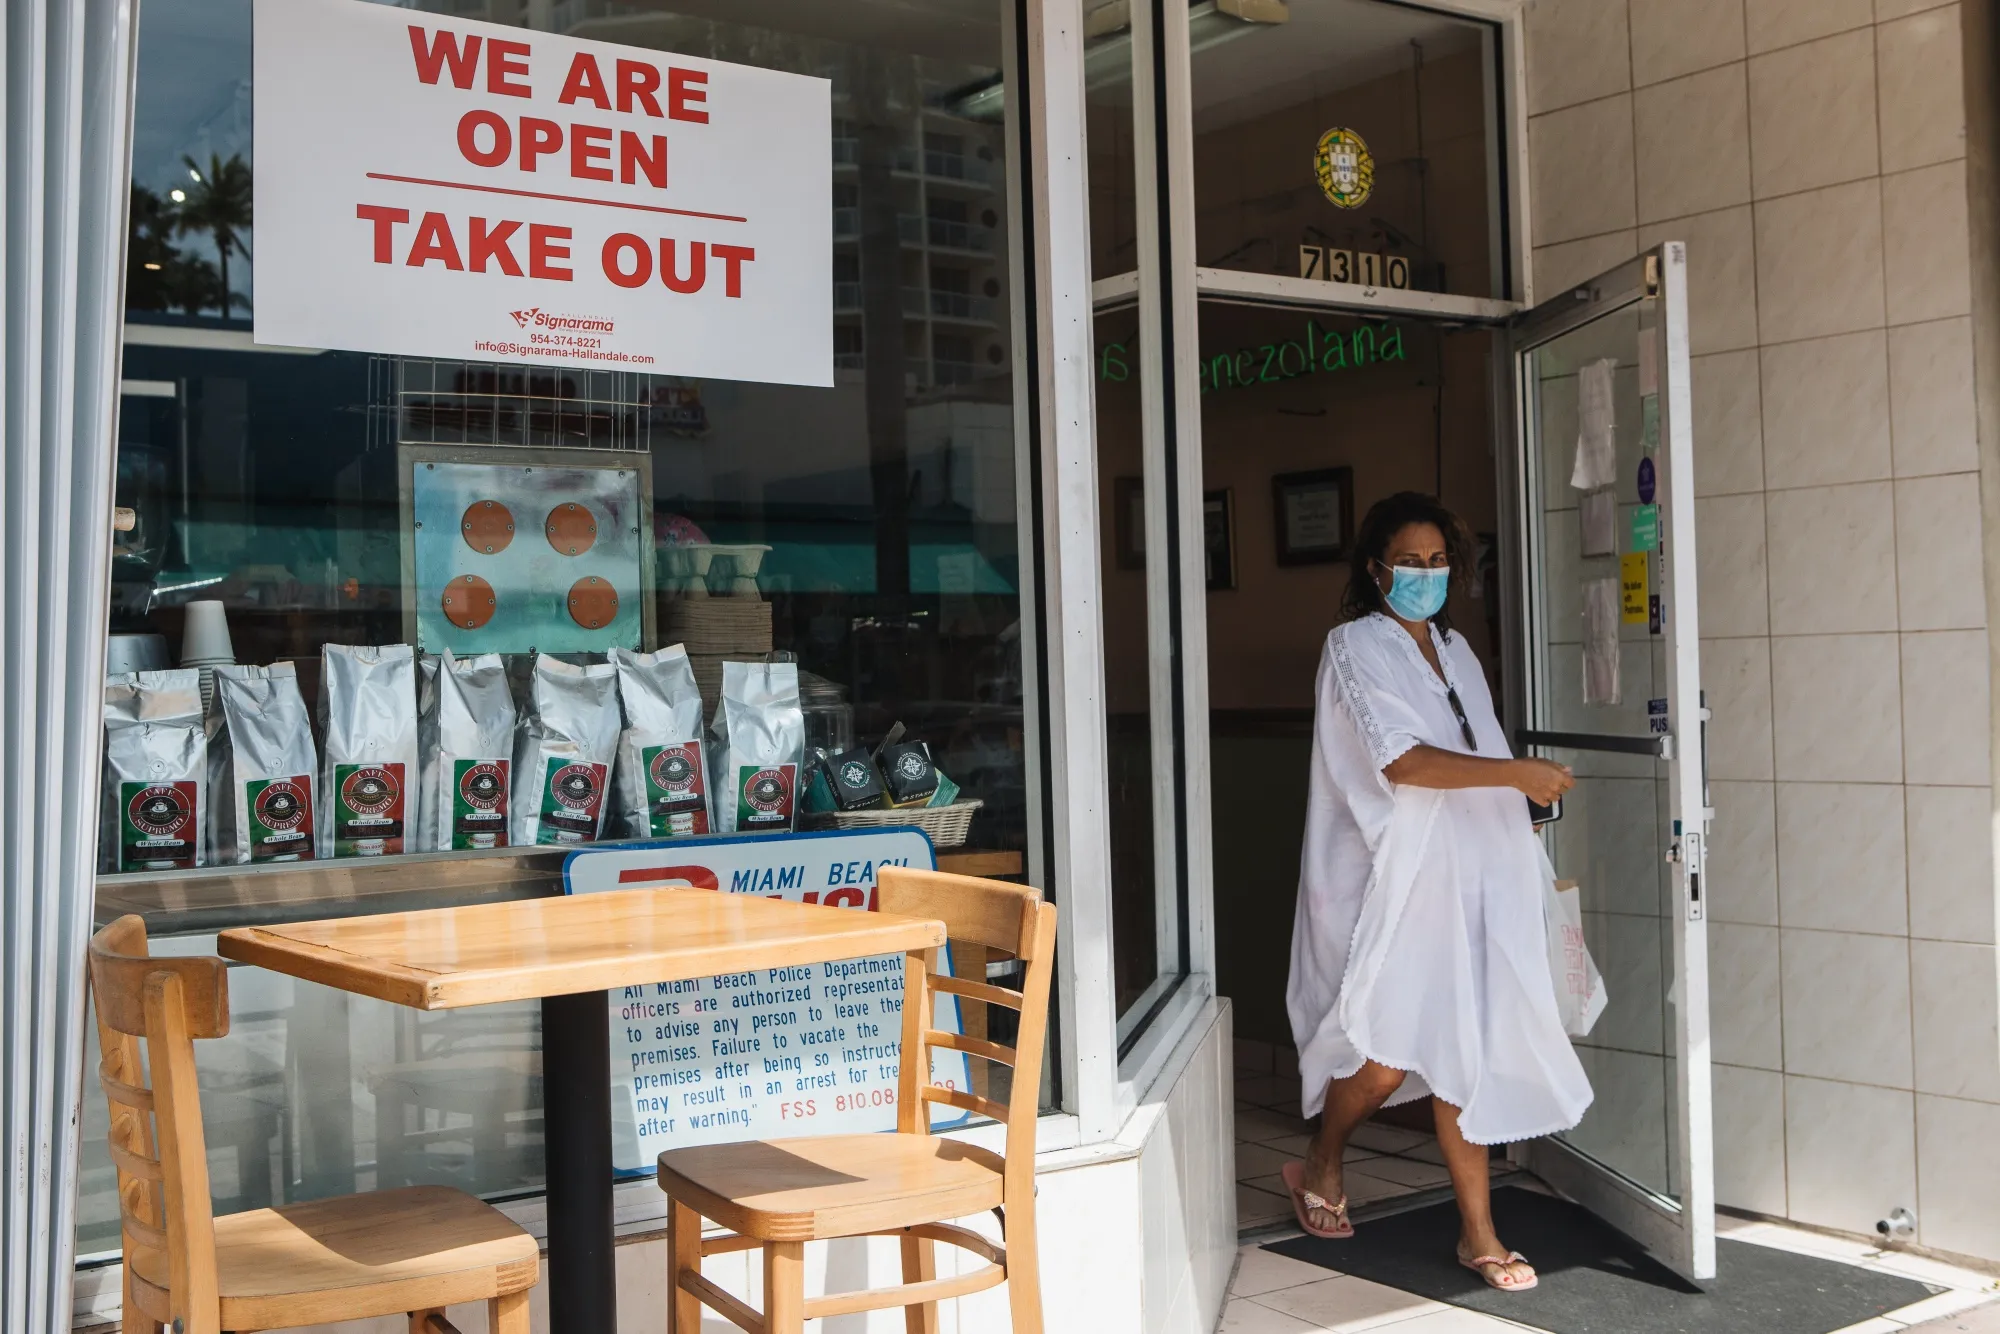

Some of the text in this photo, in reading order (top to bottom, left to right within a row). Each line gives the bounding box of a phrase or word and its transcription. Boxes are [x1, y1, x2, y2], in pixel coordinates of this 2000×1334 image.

[408, 25, 710, 125] WE ARE
[456, 110, 668, 189] OPEN
[356, 203, 755, 298] TAKE OUT
[1302, 248, 1407, 289] 7310
[534, 312, 614, 332] Signarama
[475, 340, 655, 364] info@Signarama-Hallandale.com
[530, 333, 601, 349] 954-374-8221
[1650, 717, 1668, 733] PUS
[656, 774, 695, 790] SUPREMO
[348, 798, 392, 814] SUPREMO
[464, 793, 502, 810] SUPREMO
[554, 790, 594, 809] SUPREMO
[748, 796, 785, 811] SUPREMO
[910, 790, 934, 800] STASH
[134, 817, 184, 834] SUPREMO
[261, 811, 303, 830] SUPREMO
[730, 866, 804, 893] MIAMI
[624, 956, 902, 999] All Miami Beach Police Department
[622, 975, 904, 1020] officers are authorized representat
[627, 1026, 642, 1043] to
[656, 1020, 700, 1040] advise
[714, 1018, 739, 1036] any
[752, 1010, 797, 1034] person
[808, 1006, 823, 1022] to
[835, 1003, 869, 1019] leave
[631, 1022, 879, 1072] premises. Failure to vacate the
[634, 1042, 901, 1095] premises after being so instructe
[637, 1095, 669, 1114] may
[684, 1085, 726, 1106] result
[739, 1082, 752, 1099] in
[766, 1080, 782, 1095] an
[796, 1070, 836, 1091] arrest
[849, 1067, 868, 1084] for
[638, 1118, 676, 1137] after
[780, 1099, 817, 1120] FSS
[836, 1088, 899, 1112] 810.08
